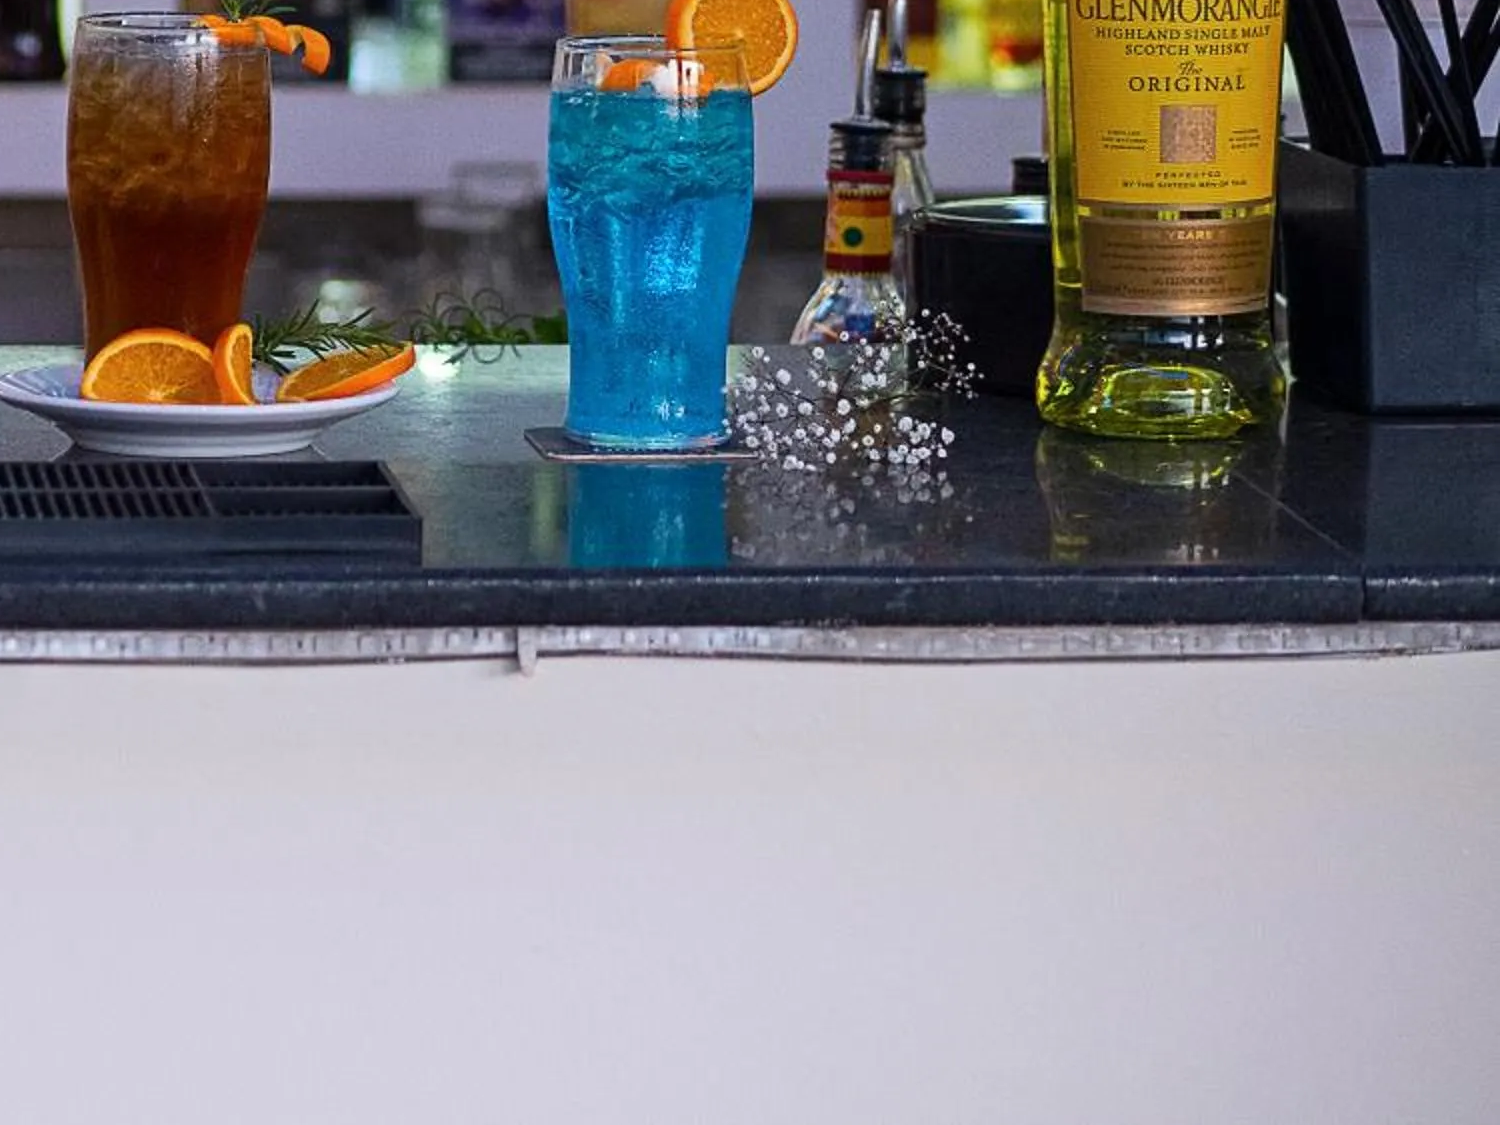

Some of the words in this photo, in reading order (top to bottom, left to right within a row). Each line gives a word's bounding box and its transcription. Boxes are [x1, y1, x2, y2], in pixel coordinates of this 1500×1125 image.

[1094, 26, 1181, 40] HIGHLAND
[1185, 27, 1237, 39] SINGLE
[1240, 25, 1271, 38] MALT
[1124, 43, 1189, 56] SCOTCH
[1193, 42, 1250, 55] WHISKY
[1128, 75, 1246, 92] ORIGINAL
